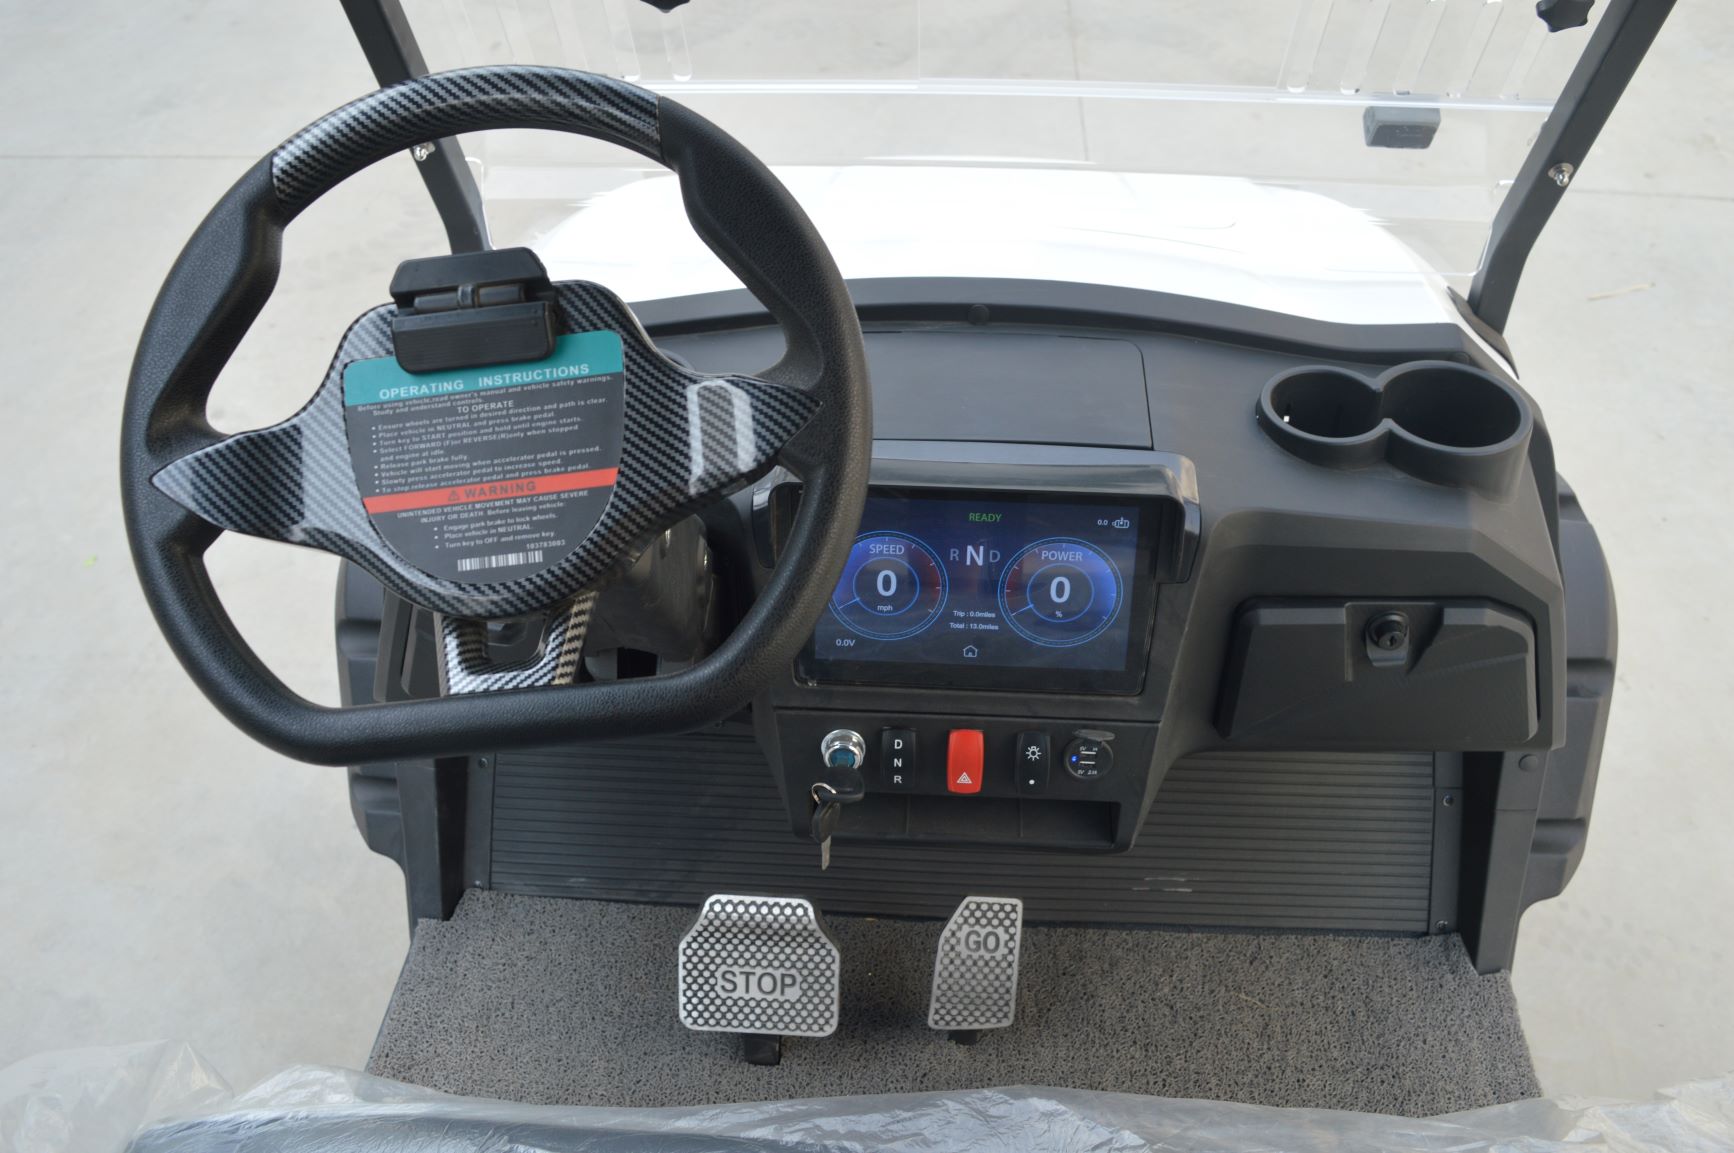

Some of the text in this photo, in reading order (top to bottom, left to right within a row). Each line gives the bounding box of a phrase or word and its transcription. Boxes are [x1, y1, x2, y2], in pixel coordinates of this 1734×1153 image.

[379, 364, 589, 400] OPERATING INSTRUCTIONS
[378, 422, 402, 430] Ensure
[405, 419, 429, 427] wheels
[444, 414, 468, 422] turned
[479, 409, 506, 418] desired
[508, 405, 541, 414] direction
[559, 401, 575, 409] path
[586, 397, 607, 405] clear.
[457, 400, 514, 413] TO OPERATE
[378, 430, 397, 438] Place
[400, 427, 425, 435] vehicle
[436, 422, 471, 431] NEUTRAL
[488, 417, 508, 426] press
[510, 414, 531, 422] brake
[397, 437, 410, 445] key
[421, 433, 445, 441] START
[447, 429, 477, 438] position
[512, 422, 529, 430] until
[531, 419, 556, 428] engine
[403, 441, 441, 451] FORWARD
[380, 461, 408, 470] Release
[410, 459, 426, 467] park
[428, 456, 448, 464] brake
[380, 469, 407, 477] Vehicle
[443, 461, 470, 471] moving
[492, 454, 534, 464] accelerator
[536, 451, 557, 459] pedal
[395, 452, 419, 461] engine
[407, 475, 428, 483] press
[429, 469, 470, 479] accelerator
[472, 466, 492, 475] pedal
[504, 462, 535, 470] increase
[464, 481, 535, 499] WARNING
[396, 508, 442, 518] UNINTENDED
[443, 504, 472, 513] VEHICLE
[474, 499, 513, 509] MOVEMENT
[533, 494, 557, 502] CAUSE
[559, 490, 588, 499] SEVERE
[420, 515, 445, 524] INJURY
[511, 504, 537, 513] leaving
[969, 513, 1002, 522] READY
[443, 523, 468, 532] Engage
[470, 521, 484, 529] park
[464, 529, 487, 537] vehicle
[462, 539, 474, 547] key
[514, 532, 539, 540] remove
[869, 544, 905, 554] SPEED
[950, 545, 1000, 566] R N D
[1042, 550, 1083, 562] POWER
[877, 570, 897, 596] 0
[1050, 576, 1071, 603] 0
[953, 610, 965, 618] Trip
[894, 739, 902, 749] D
[894, 758, 902, 768] N
[894, 775, 902, 784] R
[964, 930, 1000, 952] GO
[720, 970, 797, 996] STOP
